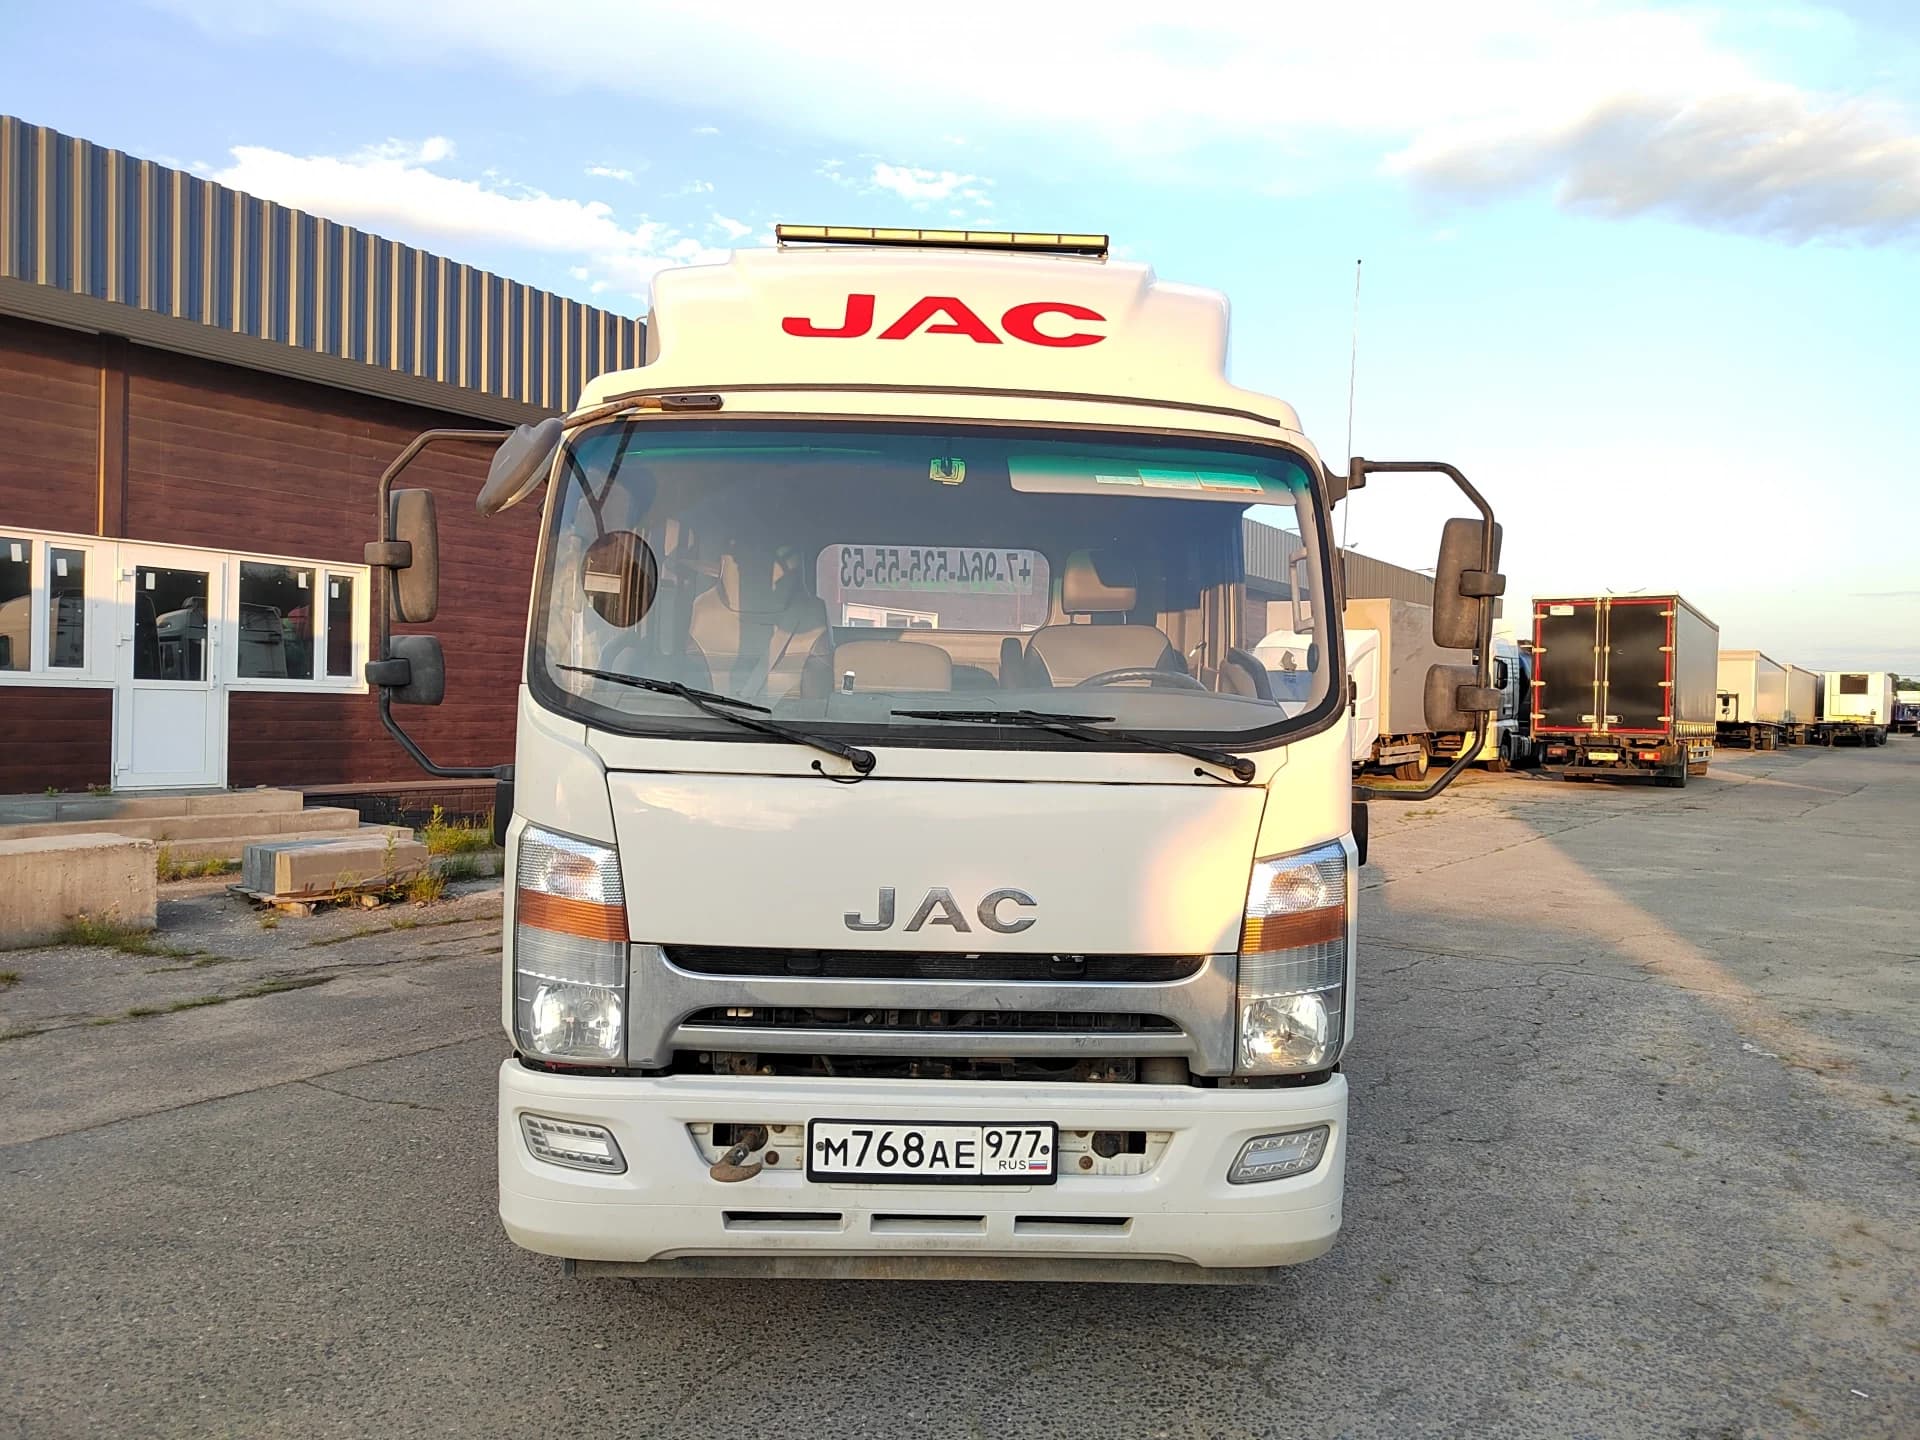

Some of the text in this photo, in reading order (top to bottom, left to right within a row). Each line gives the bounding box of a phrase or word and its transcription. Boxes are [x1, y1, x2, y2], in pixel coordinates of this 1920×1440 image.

[782, 294, 1106, 347] JAC
[844, 886, 1038, 934] JAC
[985, 1130, 1042, 1158] 977
[998, 1159, 1027, 1171] RUS
